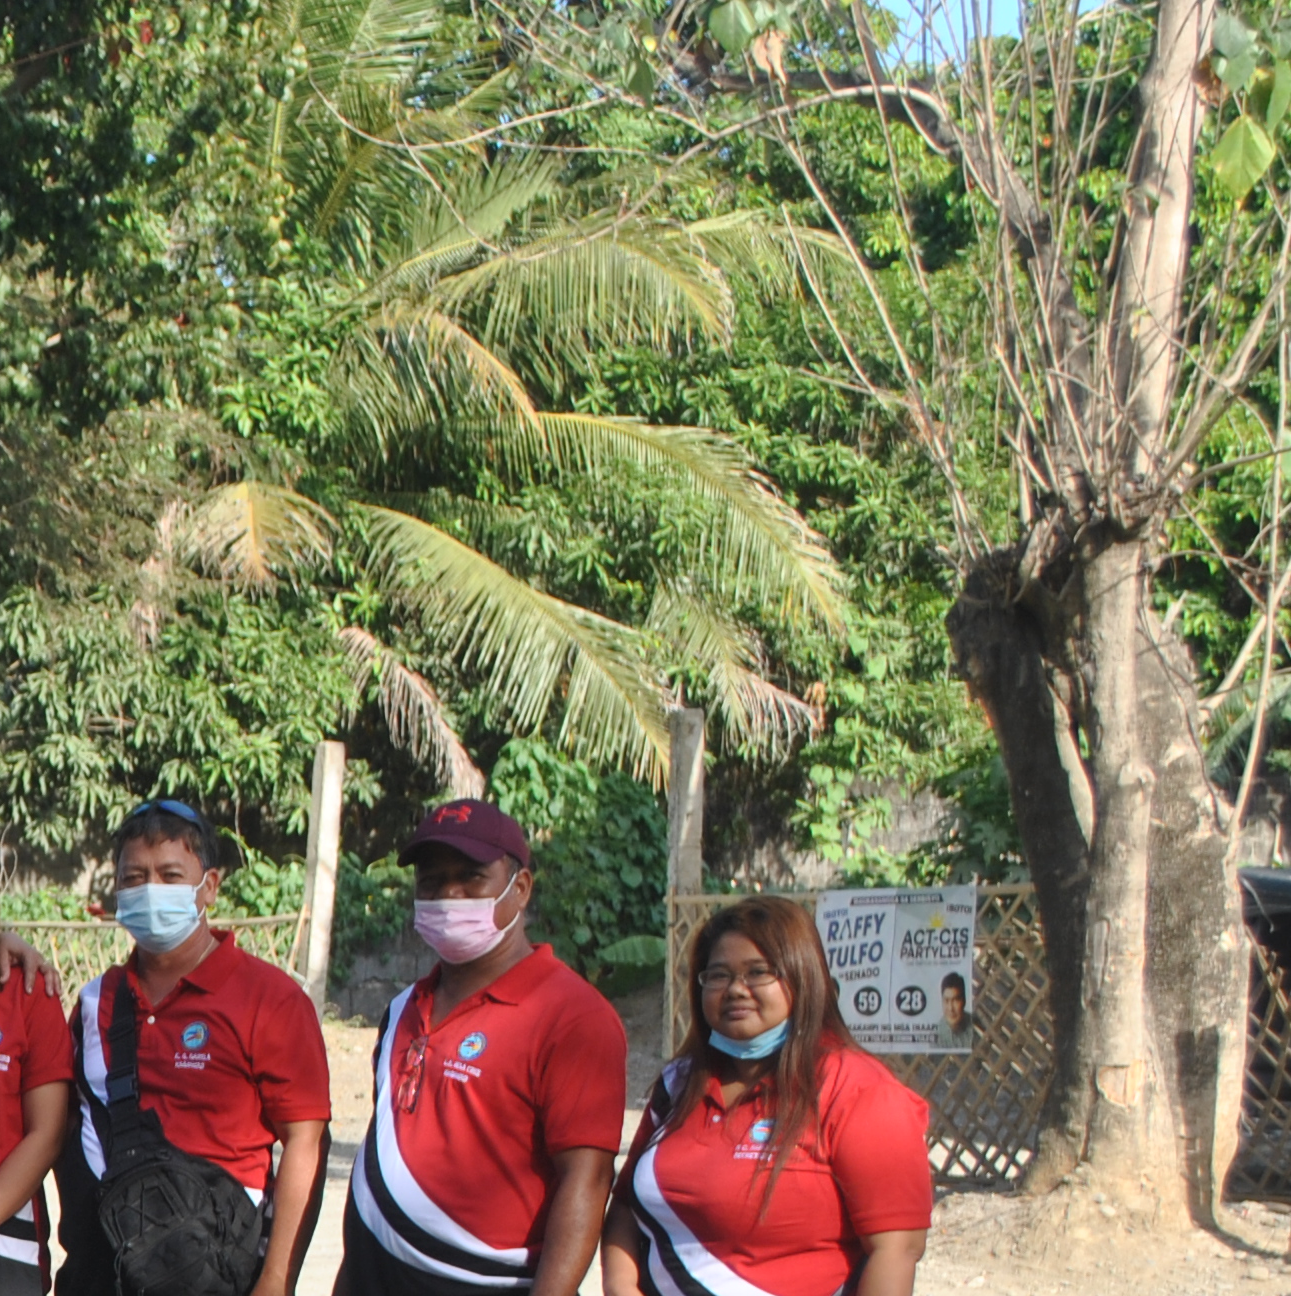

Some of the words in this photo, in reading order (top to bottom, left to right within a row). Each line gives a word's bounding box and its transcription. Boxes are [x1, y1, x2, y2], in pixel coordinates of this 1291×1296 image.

[827, 912, 886, 942] RAFFY
[901, 927, 969, 945] ACT-CIS
[828, 940, 884, 969] TULFO
[899, 944, 968, 960] PARTYLIST
[845, 967, 880, 981] SENADO
[858, 991, 879, 1011] 59
[899, 990, 923, 1011] 28
